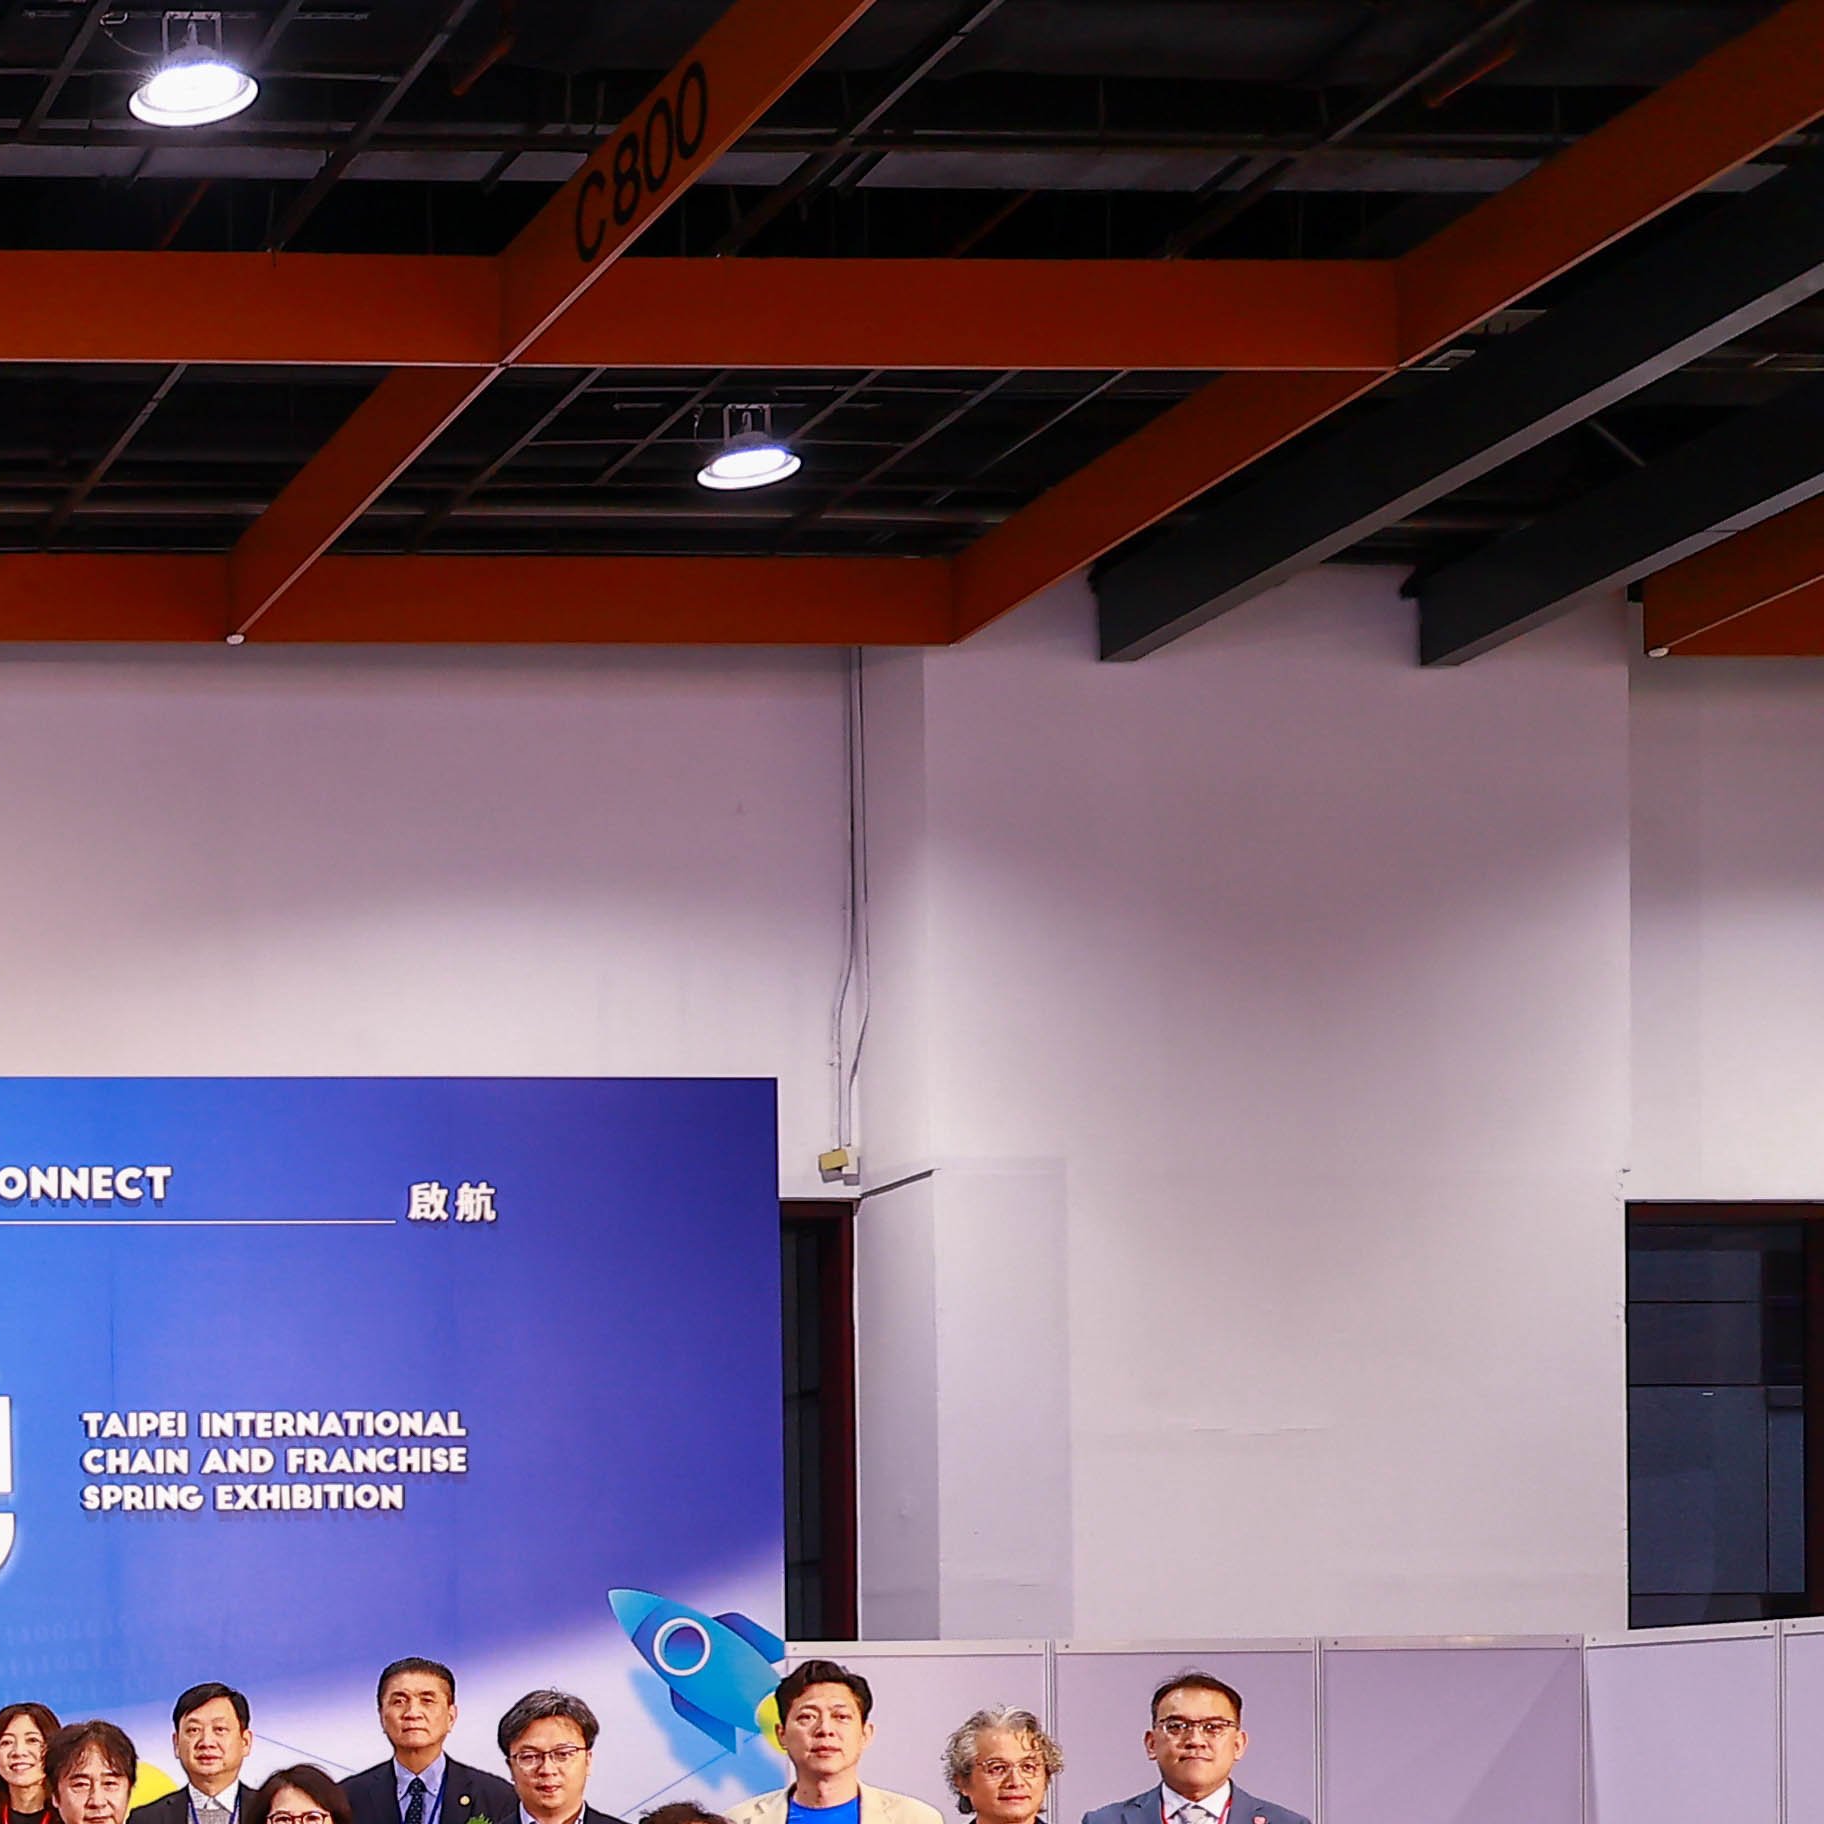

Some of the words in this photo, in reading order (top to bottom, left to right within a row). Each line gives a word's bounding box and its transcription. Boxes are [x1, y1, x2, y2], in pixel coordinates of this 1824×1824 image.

[576, 61, 708, 263] C800
[81, 1412, 187, 1439] TAIPEI
[200, 1410, 465, 1437] INTERNATIONAL
[81, 1447, 189, 1476] CHAIN
[200, 1447, 274, 1474] AND
[286, 1446, 467, 1474] FRANCHISE
[81, 1484, 204, 1513] SPRING
[213, 1483, 404, 1511] EXHIBITION
